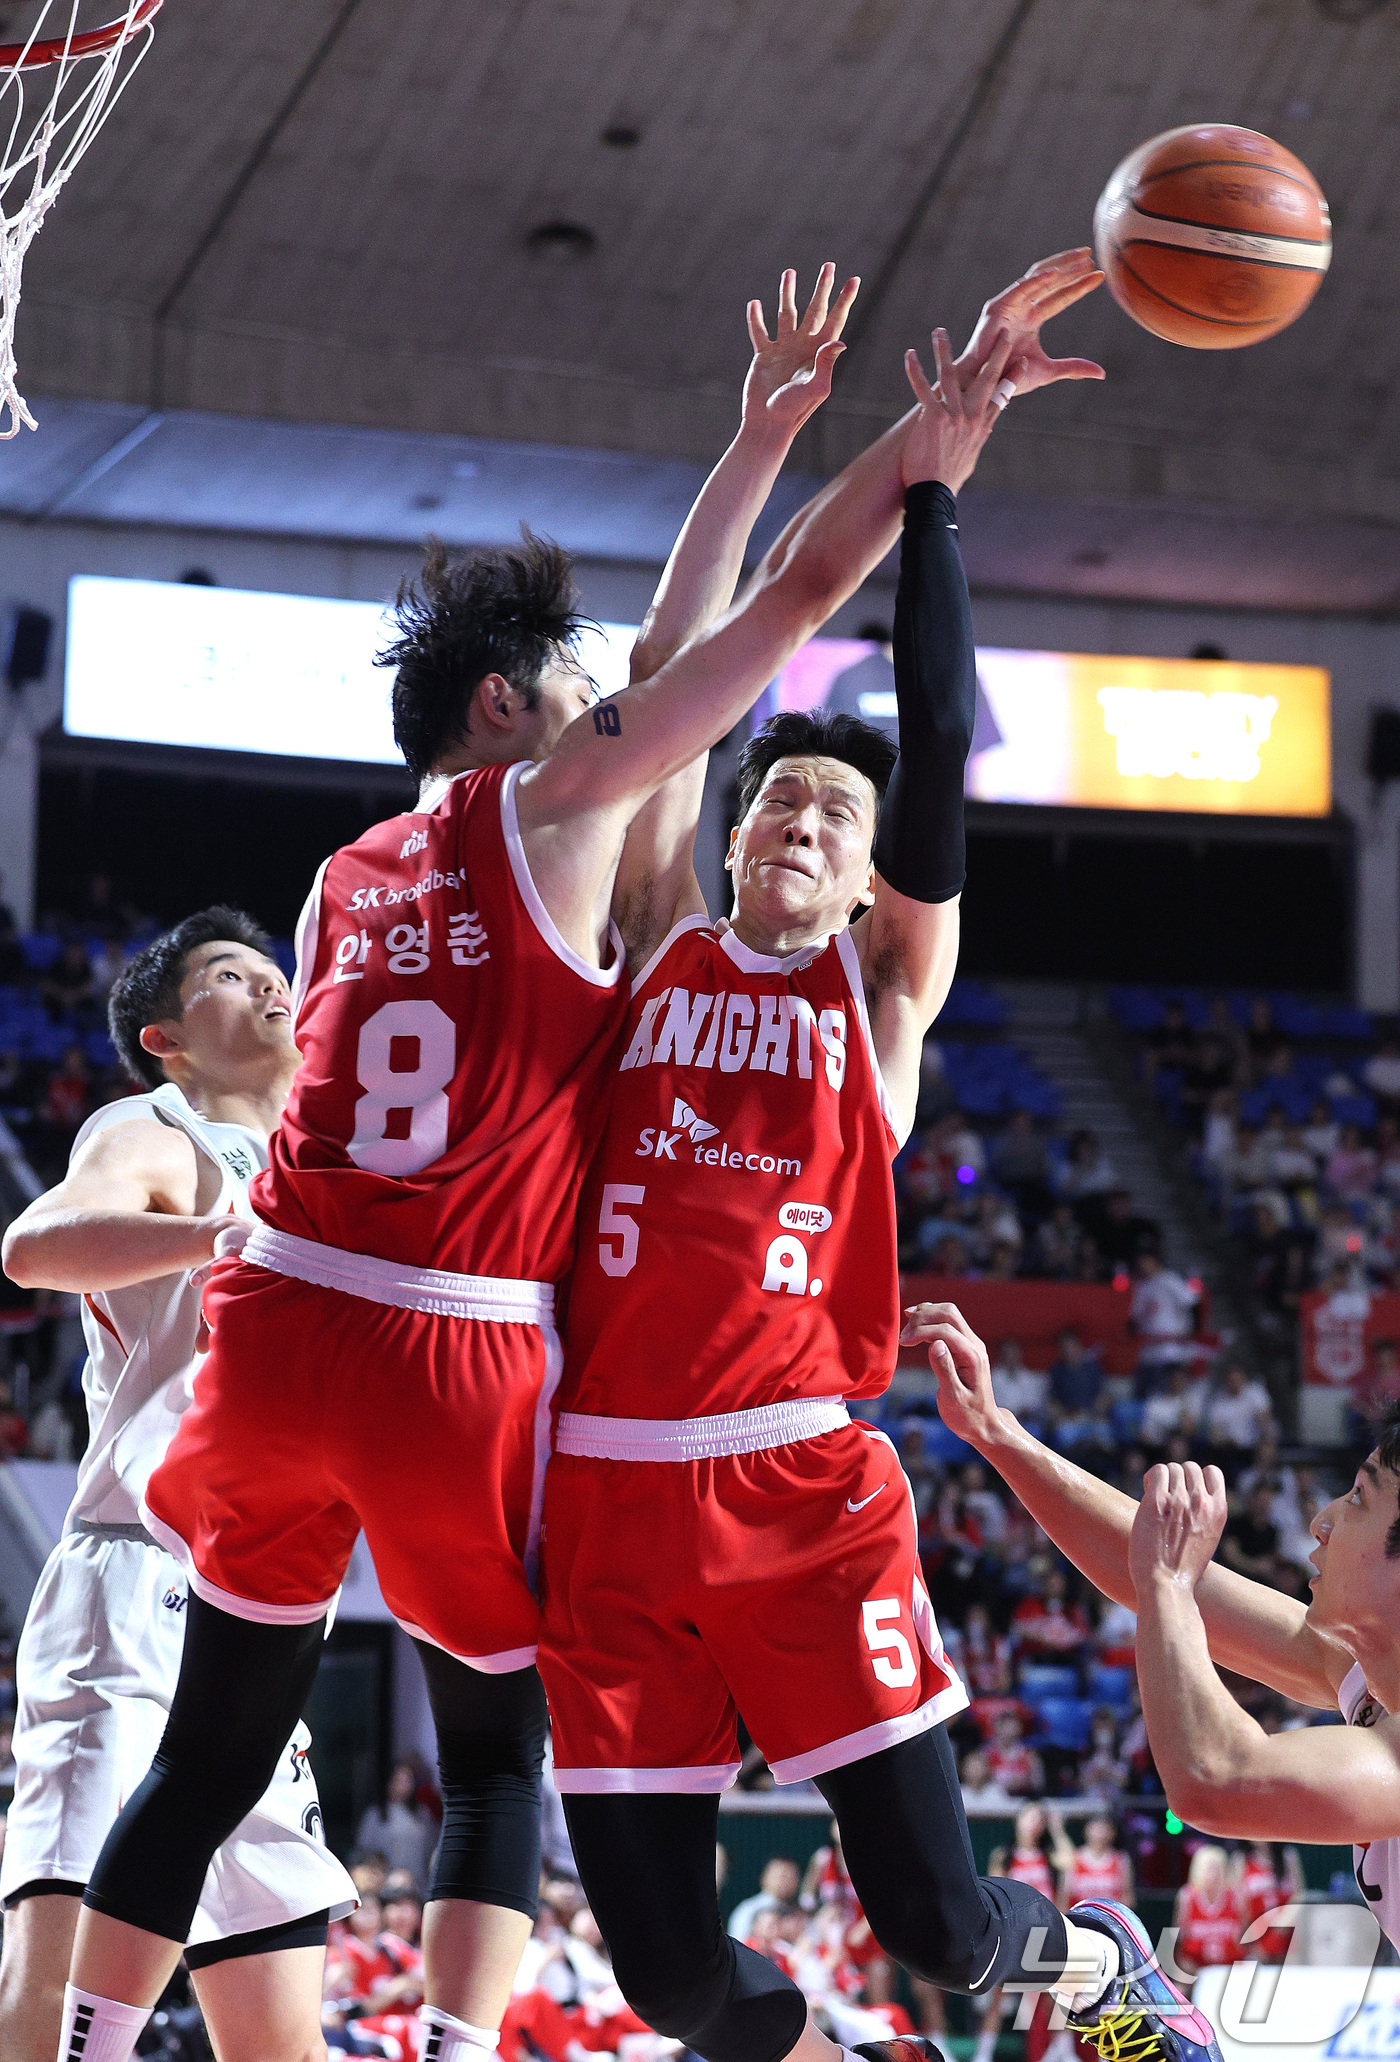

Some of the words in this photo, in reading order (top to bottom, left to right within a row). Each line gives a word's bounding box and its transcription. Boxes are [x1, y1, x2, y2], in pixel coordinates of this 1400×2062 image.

[345, 886, 387, 912] SK
[332, 909, 491, 985] 안영준
[618, 985, 848, 1094] KNIGHTS
[345, 1000, 457, 1177] 8
[634, 1126, 683, 1161] SK
[694, 1142, 802, 1177] telecom
[598, 1183, 647, 1278] 5
[785, 1207, 825, 1229] 에이닷
[861, 1597, 918, 1689] 5
